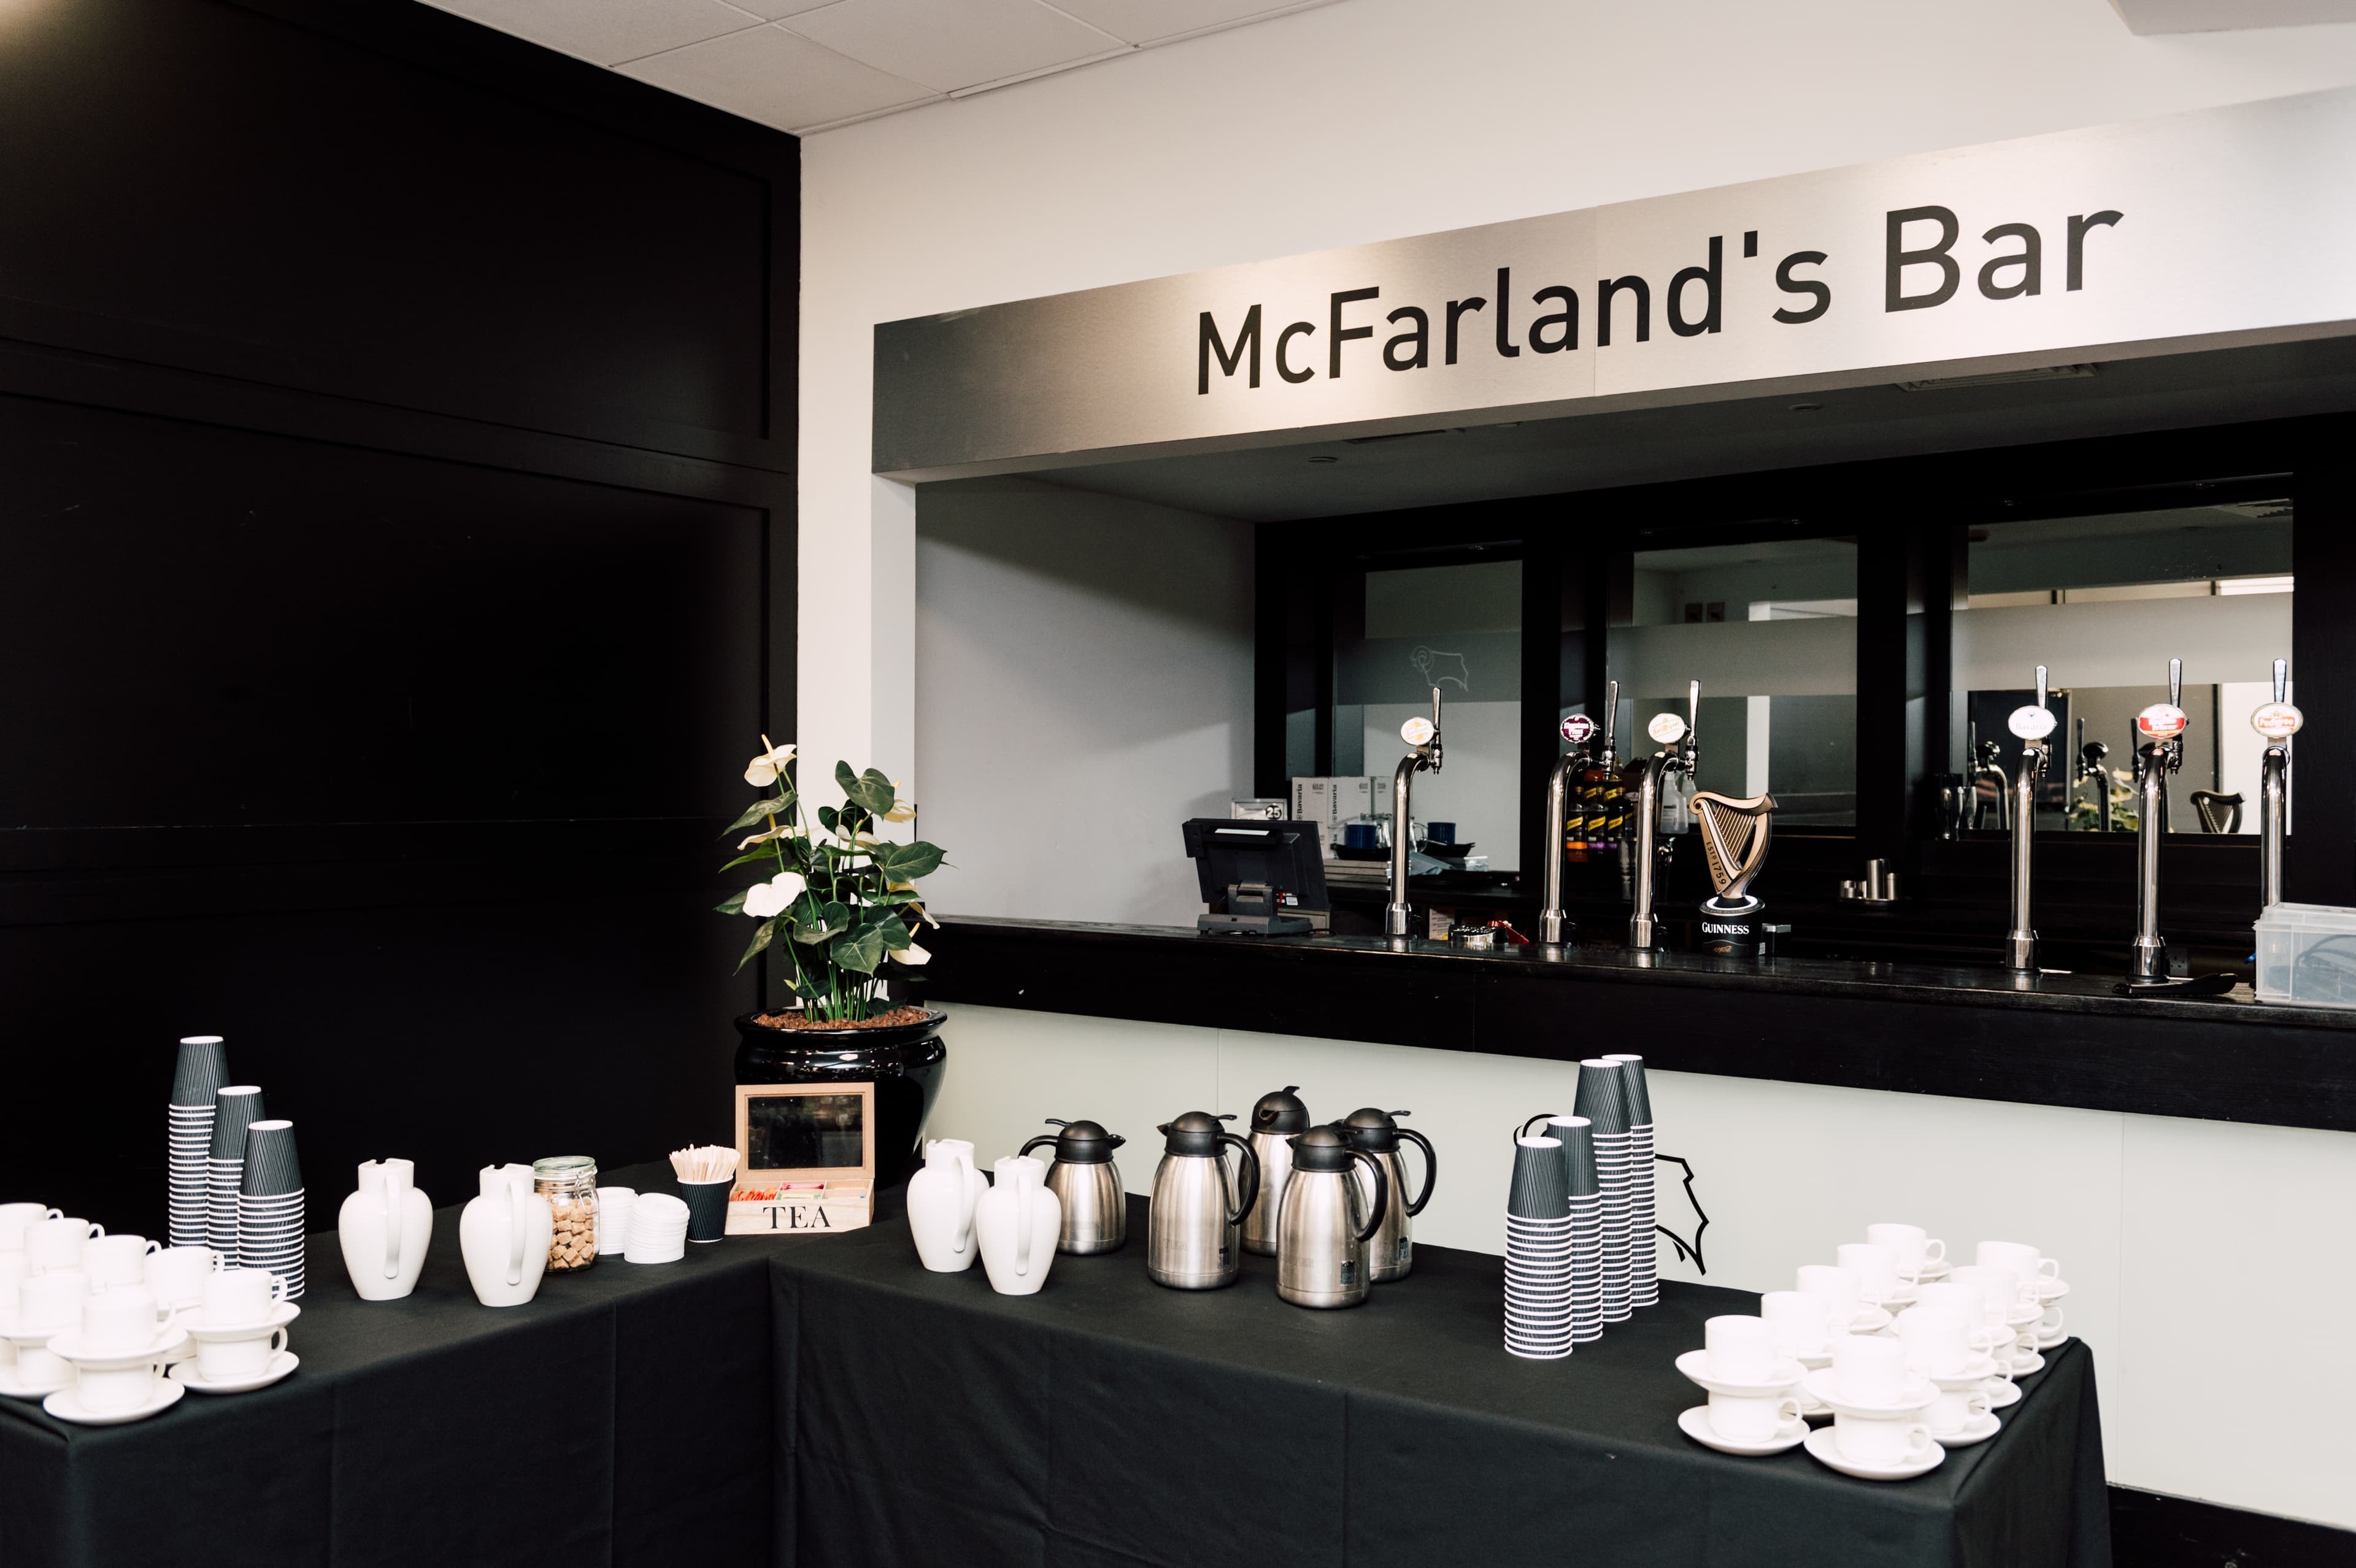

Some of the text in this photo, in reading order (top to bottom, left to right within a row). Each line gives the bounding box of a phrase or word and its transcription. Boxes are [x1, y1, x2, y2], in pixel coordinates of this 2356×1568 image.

[1198, 206, 2124, 395] McFarland's Bar
[1266, 807, 1281, 819] 25
[1712, 861, 1727, 885] 1759
[1702, 921, 1750, 935] GUINNESS
[763, 1205, 831, 1229] TEA
